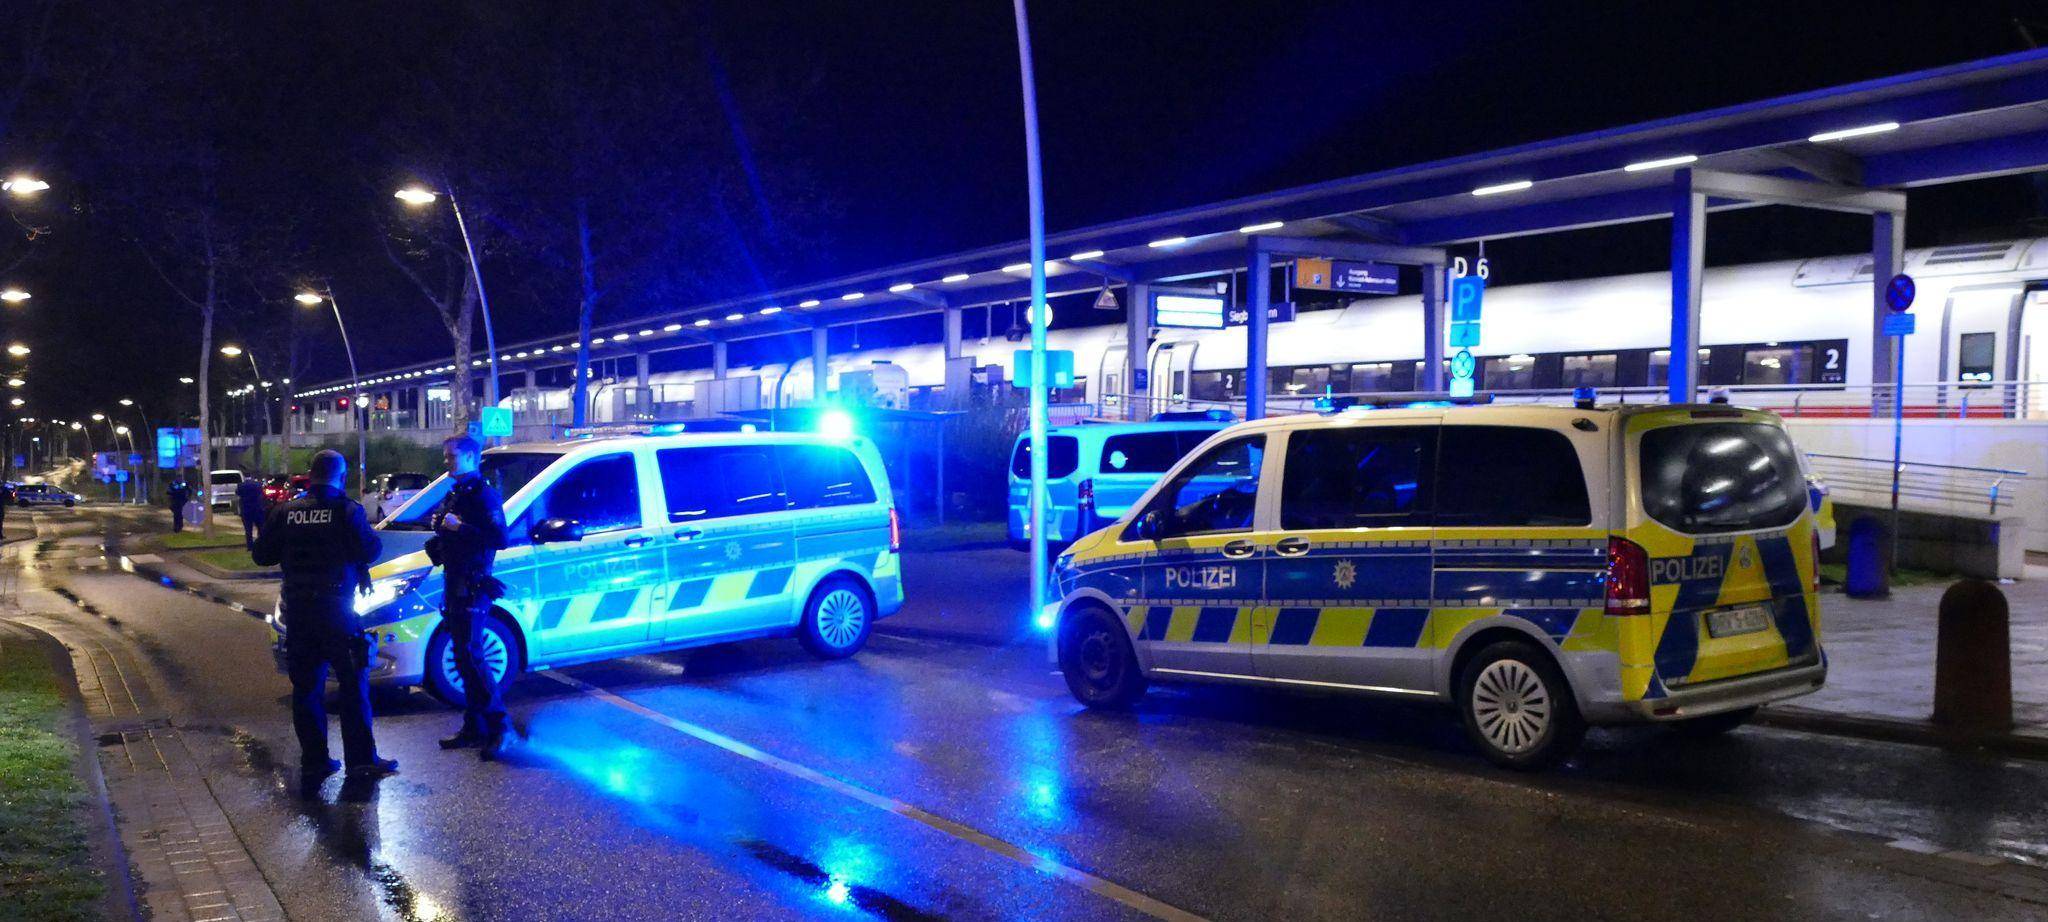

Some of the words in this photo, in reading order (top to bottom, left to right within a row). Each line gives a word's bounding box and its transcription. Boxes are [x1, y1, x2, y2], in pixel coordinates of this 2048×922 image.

[1454, 256, 1468, 278] D
[1476, 257, 1490, 280] 6
[1458, 282, 1476, 317] P
[1825, 348, 1840, 370] 2
[1225, 374, 1234, 389] 2
[286, 509, 333, 525] POLIZEI
[1165, 565, 1237, 589] POLIZEI
[1651, 554, 1724, 582] POLIZEI
